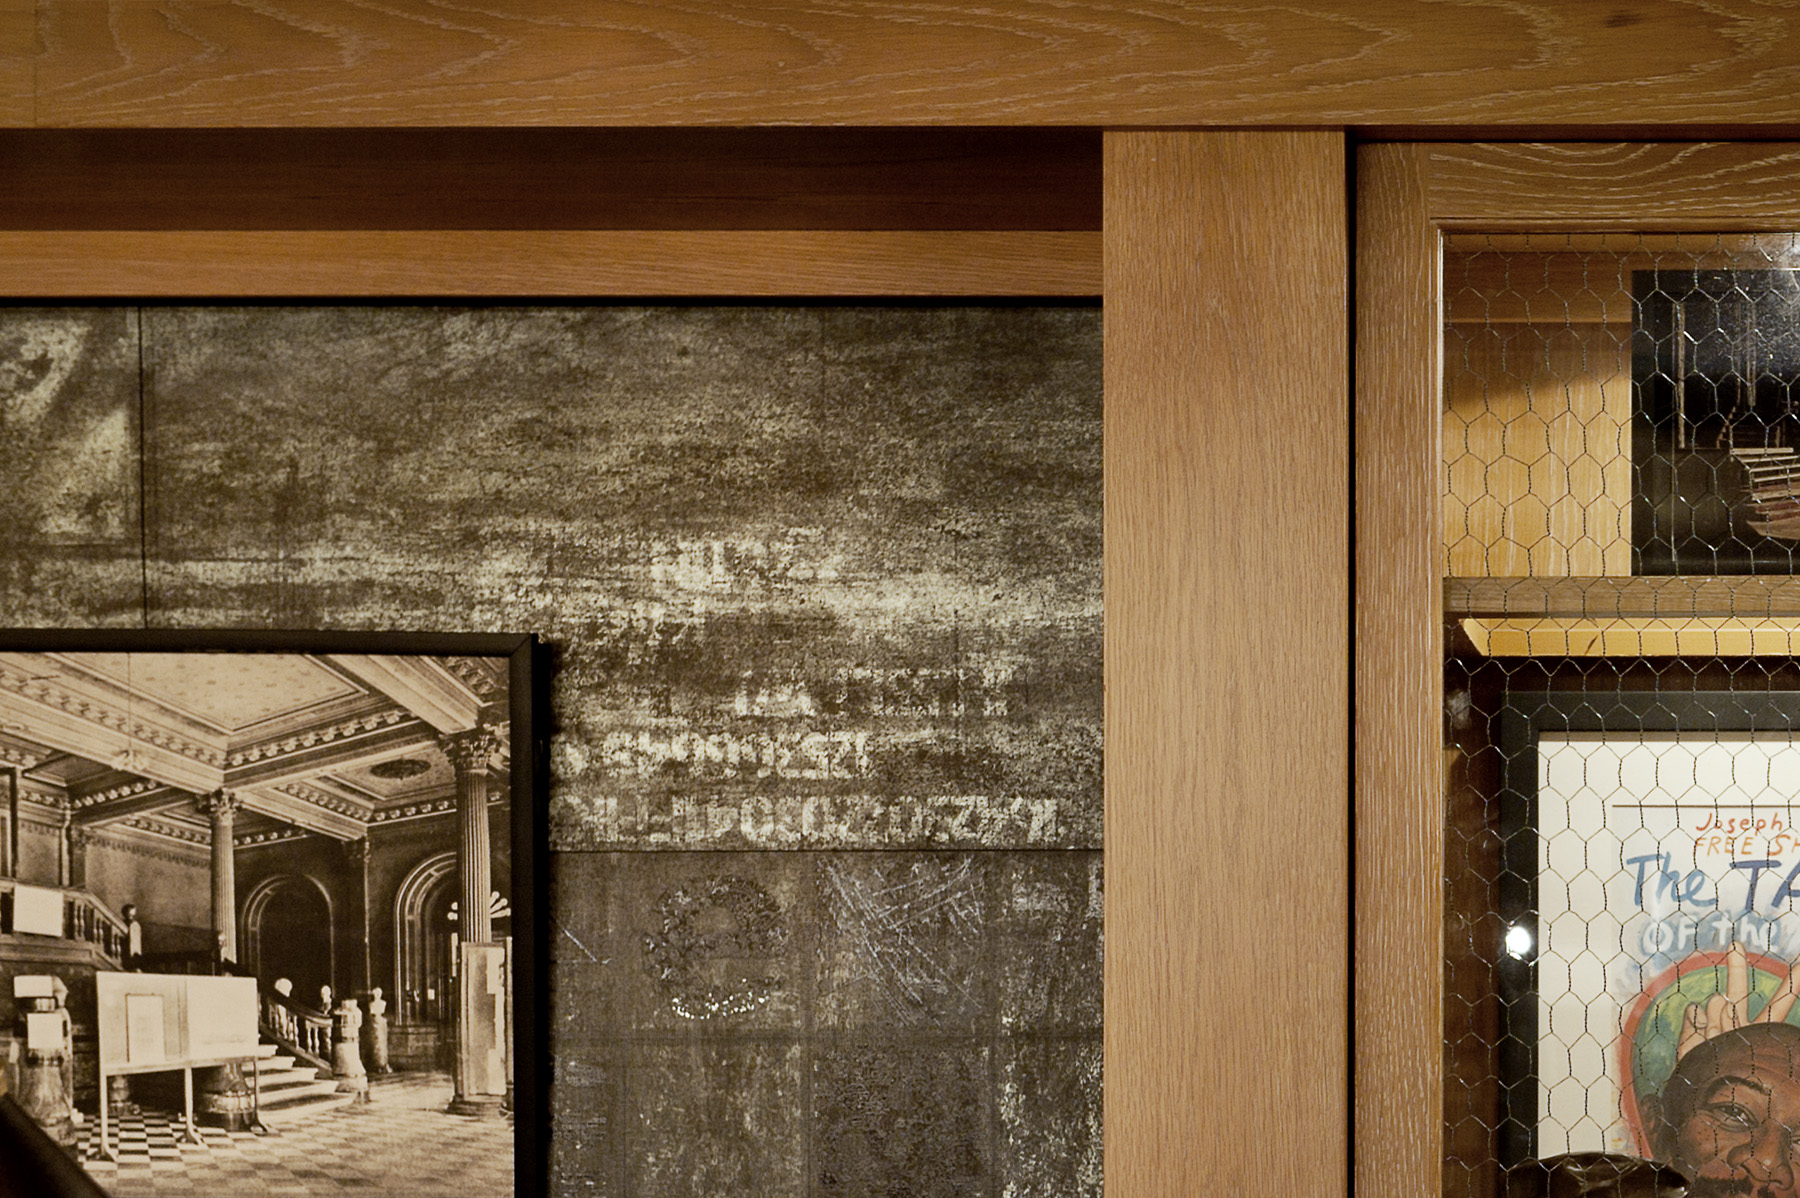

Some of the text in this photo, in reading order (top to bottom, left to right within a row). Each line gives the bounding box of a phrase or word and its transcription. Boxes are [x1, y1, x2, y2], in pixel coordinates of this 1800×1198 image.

[1696, 812, 1783, 836] Joseph
[1695, 835, 1754, 857] FREE
[1626, 851, 1717, 907] The
